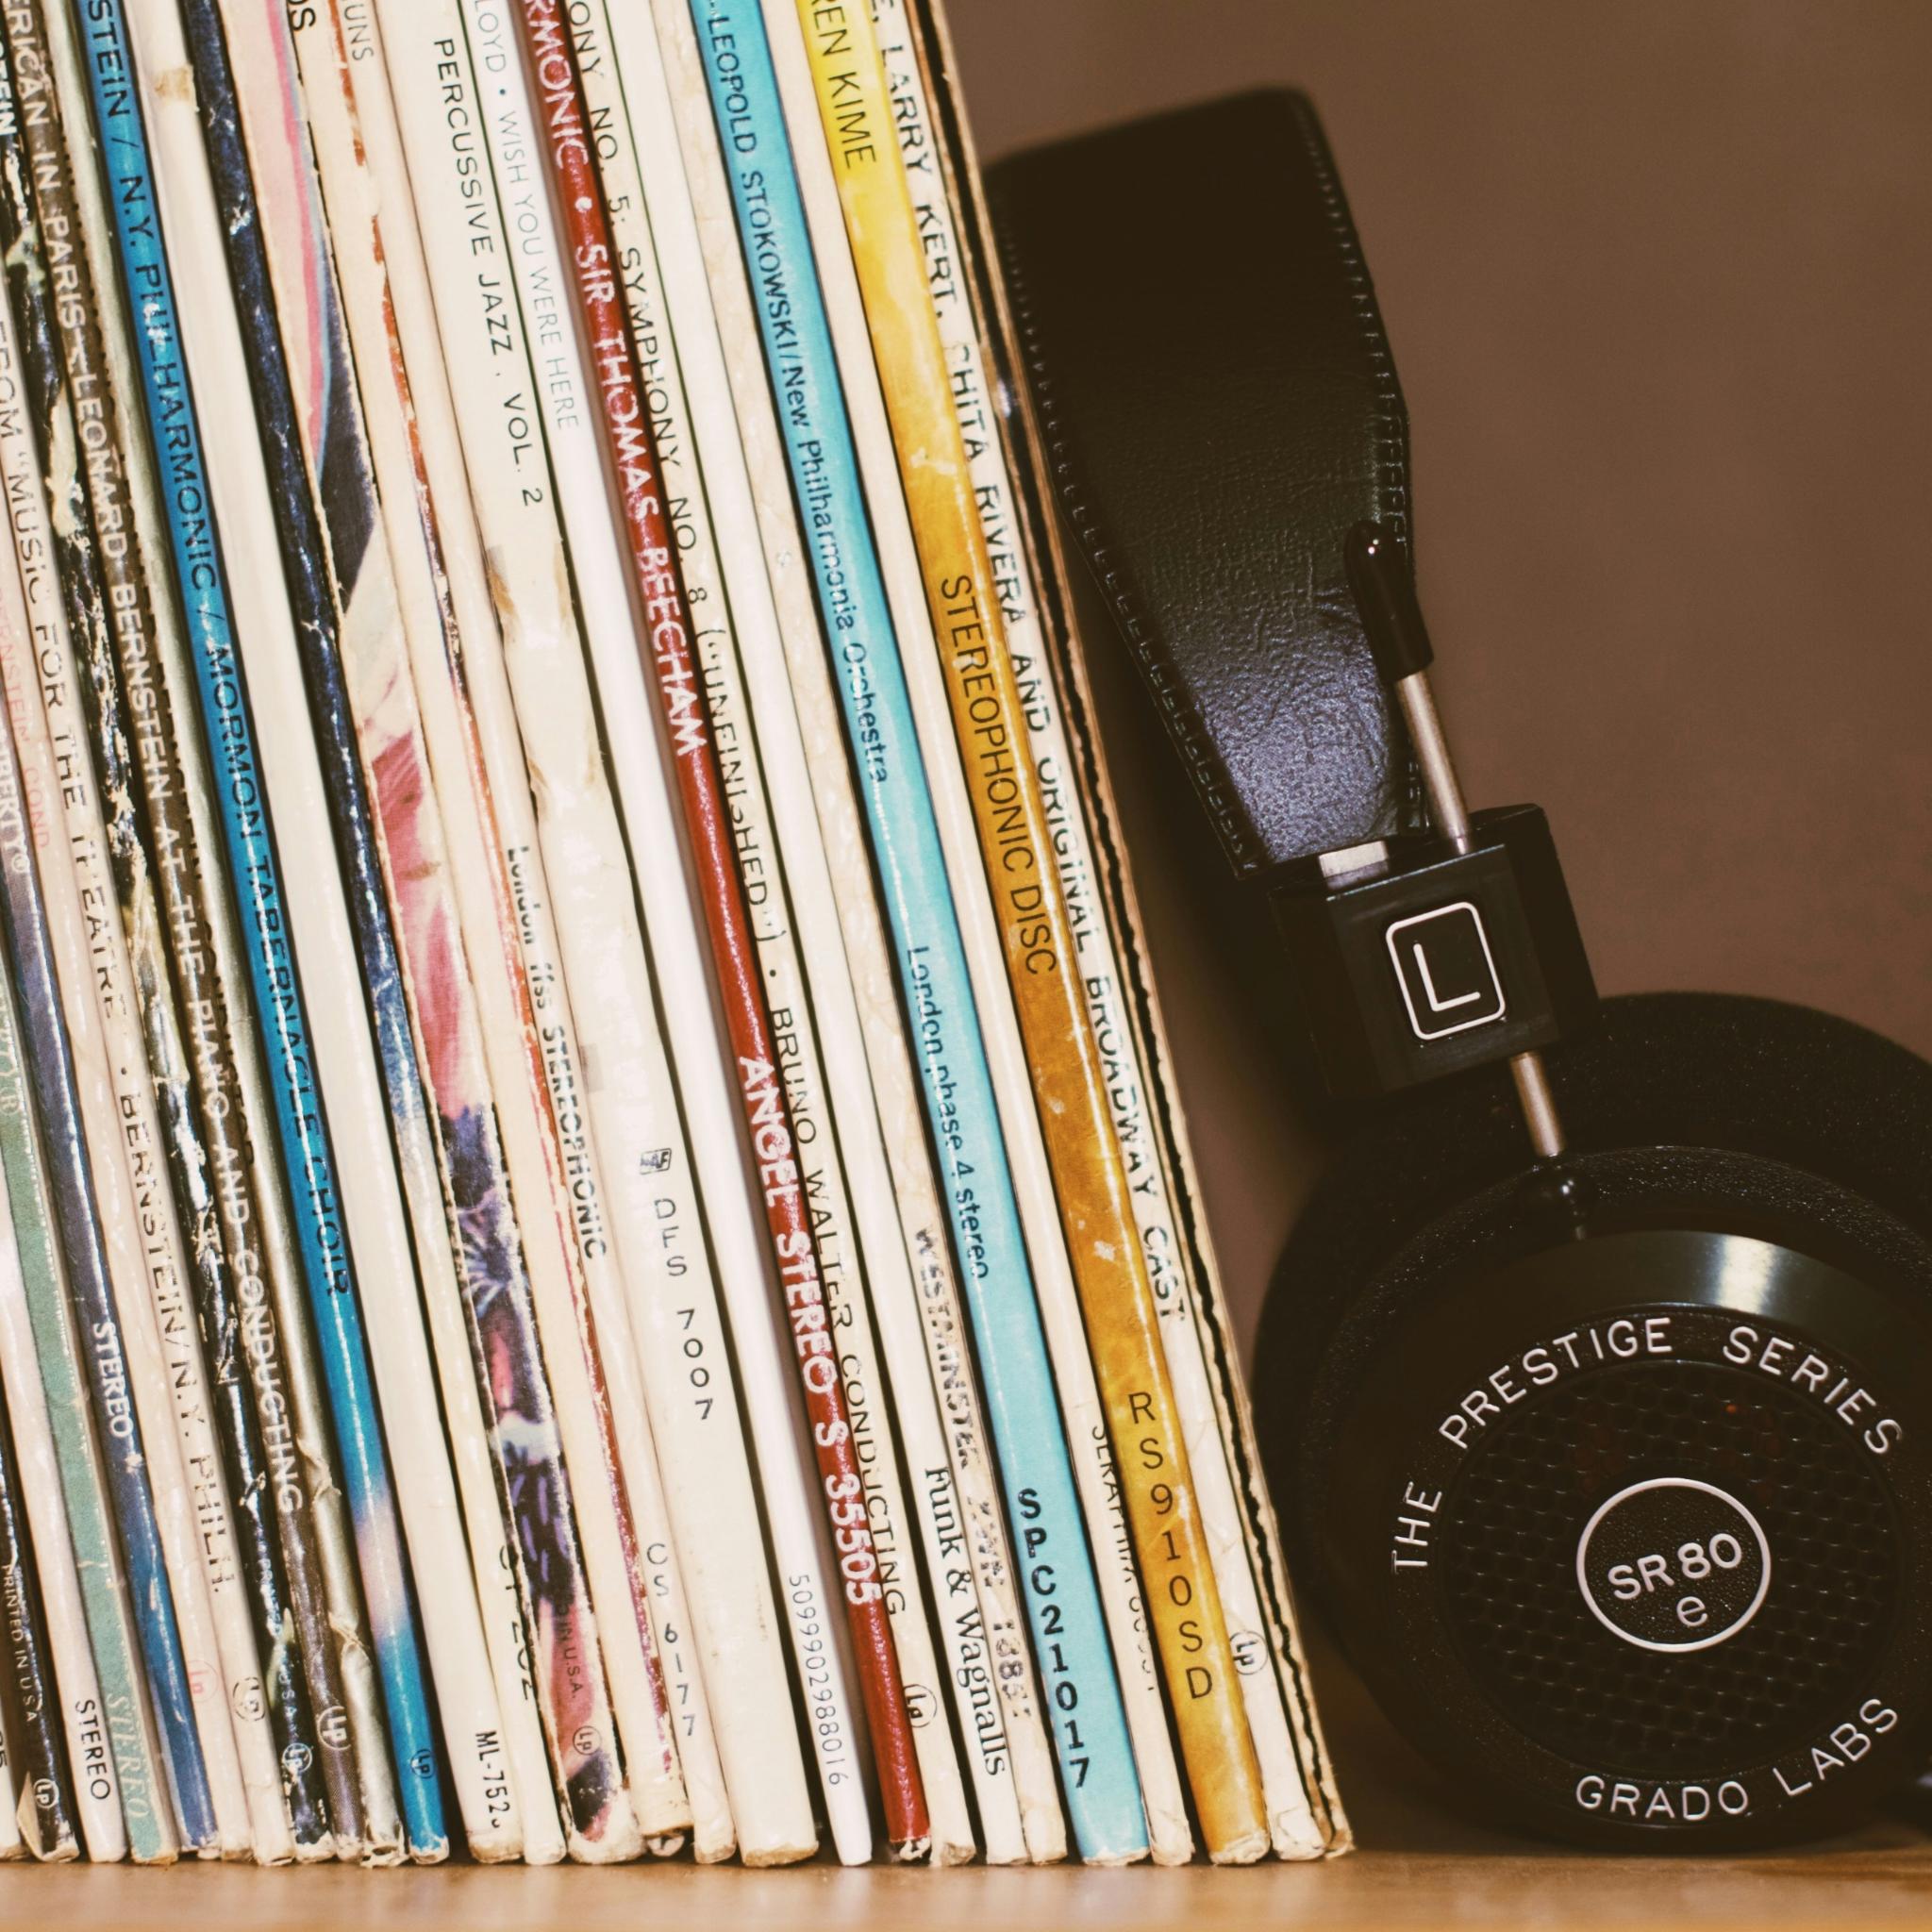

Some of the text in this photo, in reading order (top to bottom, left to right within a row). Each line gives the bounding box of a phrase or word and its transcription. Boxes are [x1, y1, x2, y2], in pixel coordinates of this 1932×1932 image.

[30, 150, 61, 191] IN
[494, 111, 528, 185] WISH
[826, 71, 876, 171] KIME
[40, 214, 88, 330] PARIS
[116, 175, 155, 247] N.Y.
[432, 38, 494, 257] PERCUSSIVE
[501, 392, 536, 473] VOL.
[521, 486, 543, 507] 2
[510, 193, 543, 257] YOU
[571, 241, 617, 308] SIR
[525, 267, 561, 346] WERE
[134, 262, 217, 591] PHILHARMONIC
[544, 357, 577, 431] HERE
[590, 328, 660, 521] THOMAS
[706, 14, 758, 156] LEOPOLD
[796, 439, 859, 631] Philharmonia
[839, 641, 893, 785] Orchestra
[67, 373, 132, 558] LEONARD
[31, 623, 71, 708] FOR
[109, 582, 173, 800] BERNSTEIN
[634, 544, 708, 757] BEECHAM
[879, 43, 933, 179] LARRY
[974, 484, 1028, 626] RIVERA
[1010, 650, 1053, 735] AND
[1034, 755, 1102, 955] ORIGINAL
[1084, 974, 1157, 1200] BROADWAY
[1141, 1223, 1187, 1324] CAST
[50, 728, 90, 809] THE
[203, 647, 266, 840] MORMON
[938, 574, 1058, 976] STEREOPHONIC DISC
[153, 823, 186, 874] AT
[167, 895, 206, 978] THE
[615, 246, 683, 472] SYMPHONY
[666, 495, 700, 563] NO.
[684, 586, 708, 606] 8
[769, 1006, 817, 1145] BRUNO
[801, 1169, 855, 1329] WALTER
[837, 1353, 908, 1615] CONDUCTING
[1413, 943, 1480, 1011] L
[184, 998, 234, 1122] PIANO
[243, 856, 320, 1139] TABERNACLE
[505, 844, 547, 945] London
[539, 1024, 608, 1260] STEREOPHONIC
[906, 944, 994, 1280] London phase 4 stereo
[211, 1141, 251, 1226] AND
[299, 1155, 351, 1296] CHOIR
[652, 1195, 718, 1422] DFS 7007
[737, 1050, 883, 1607] ANGEL STEREO S 35505
[89, 1320, 137, 1440] STEREO
[231, 1249, 304, 1514] CONDUCTING
[1391, 1317, 1903, 1574] THE PRESTIGE SERIES
[923, 1464, 1011, 1778] Funk & Wagnalls
[1607, 1533, 1742, 1601] SR 80
[1675, 1595, 1708, 1627] e
[786, 1573, 851, 1787] 5099902988016
[71, 1698, 113, 1802] STEREO
[102, 1690, 152, 1822] STEREO
[1575, 1698, 1898, 1821] GRADO LABS
